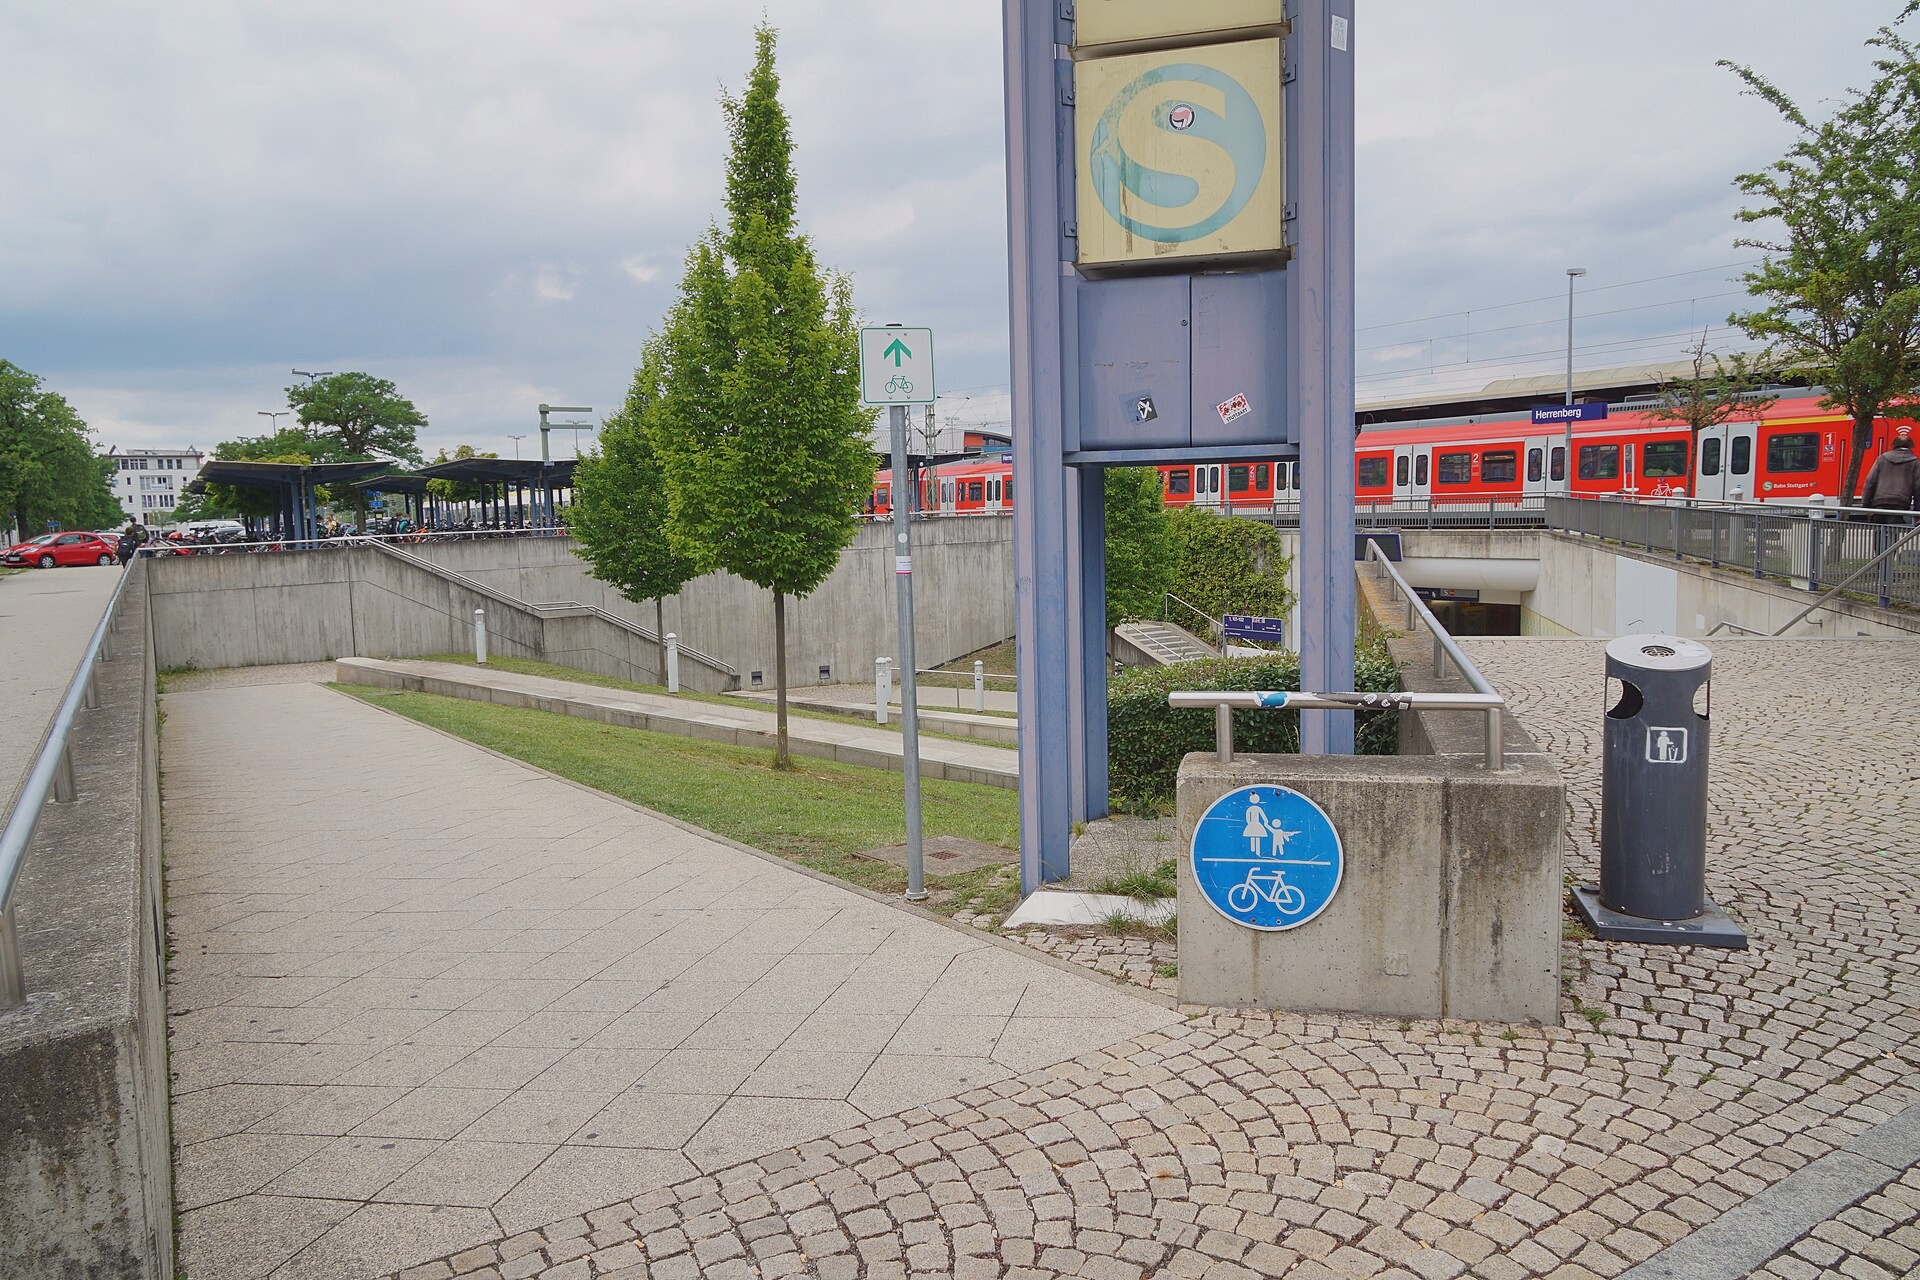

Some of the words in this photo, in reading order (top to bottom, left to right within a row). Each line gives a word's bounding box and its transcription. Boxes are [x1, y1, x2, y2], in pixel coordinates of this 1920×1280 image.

[1117, 78, 1238, 229] S
[1535, 408, 1582, 419] Herrenberg
[1825, 432, 1833, 445] 1
[1473, 453, 1479, 463] 2
[1163, 471, 1168, 479] 2
[1249, 465, 1255, 475] 2
[1763, 481, 1773, 491] S
